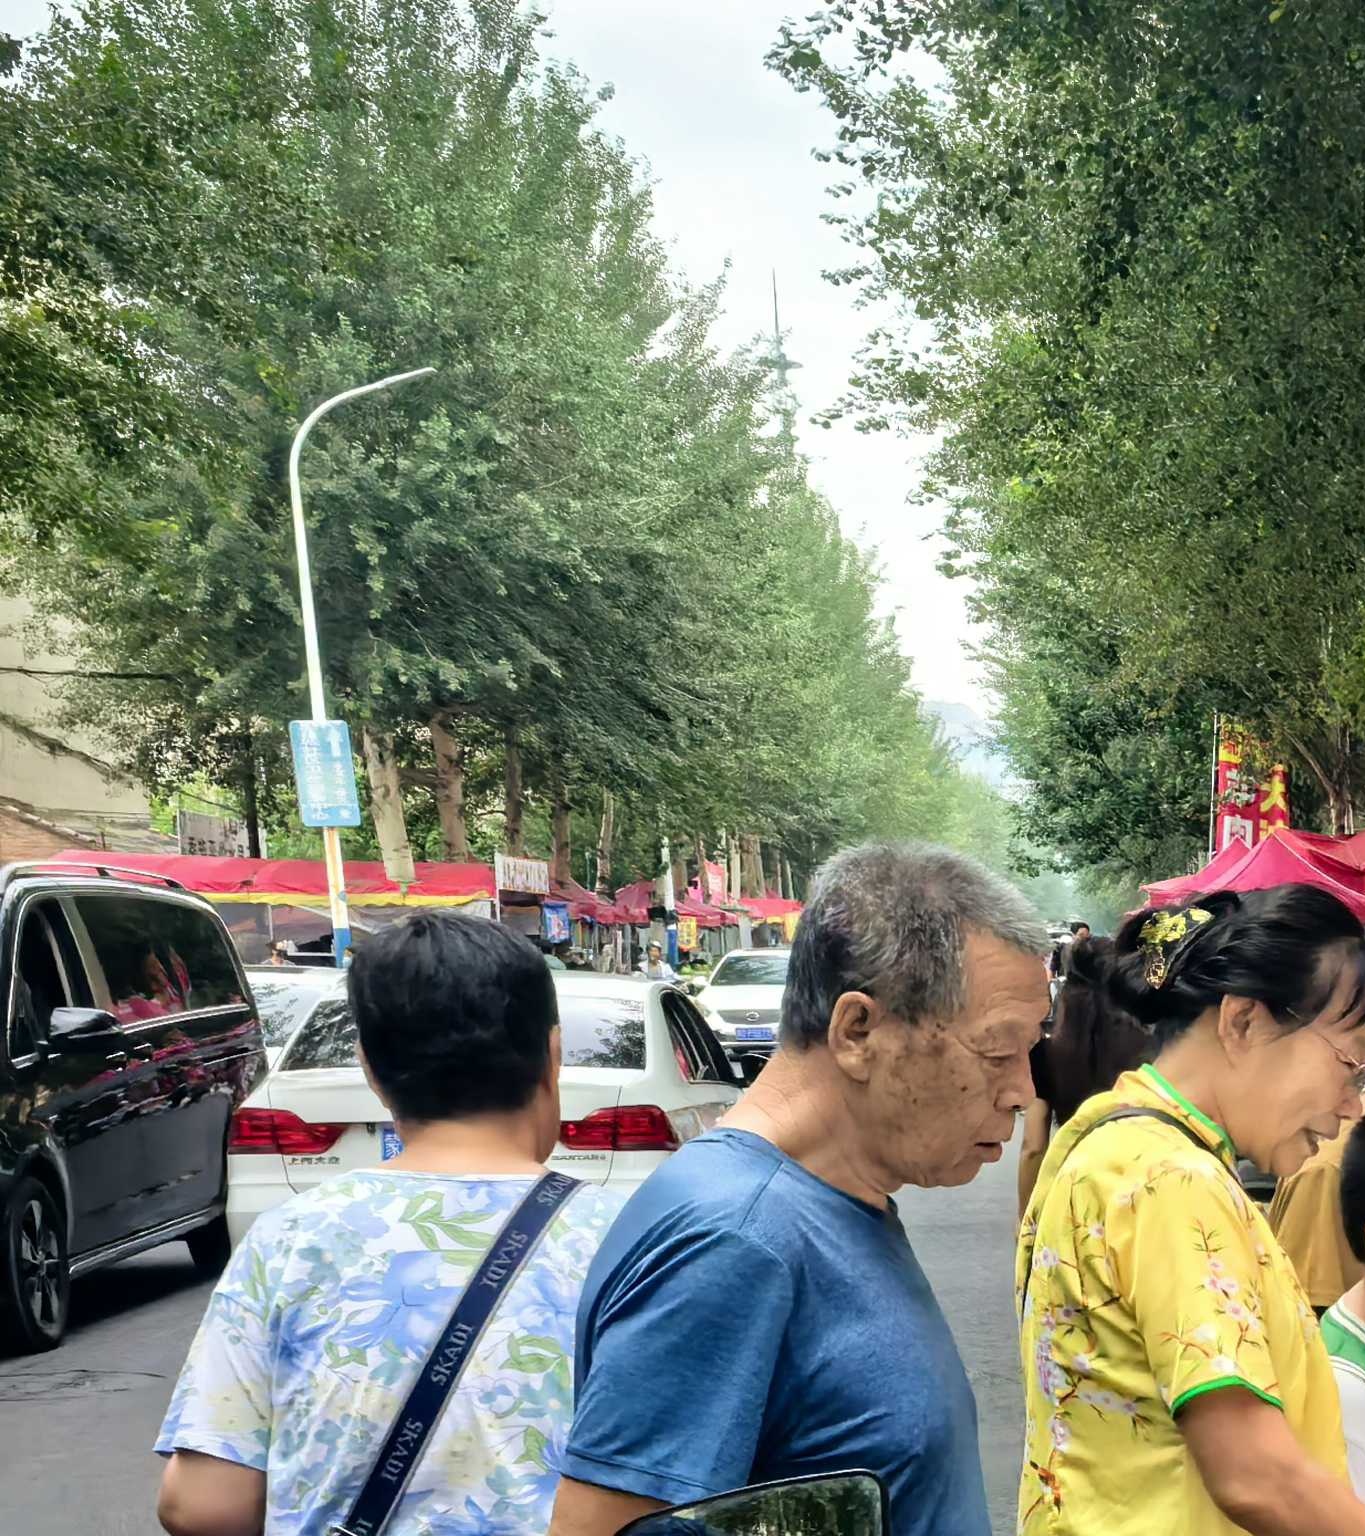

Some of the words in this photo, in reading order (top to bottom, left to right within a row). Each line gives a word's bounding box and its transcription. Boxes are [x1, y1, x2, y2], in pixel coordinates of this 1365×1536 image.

[479, 1230, 528, 1289] SKADI
[431, 1322, 474, 1386] SKADI
[382, 1417, 424, 1484] SKADI
